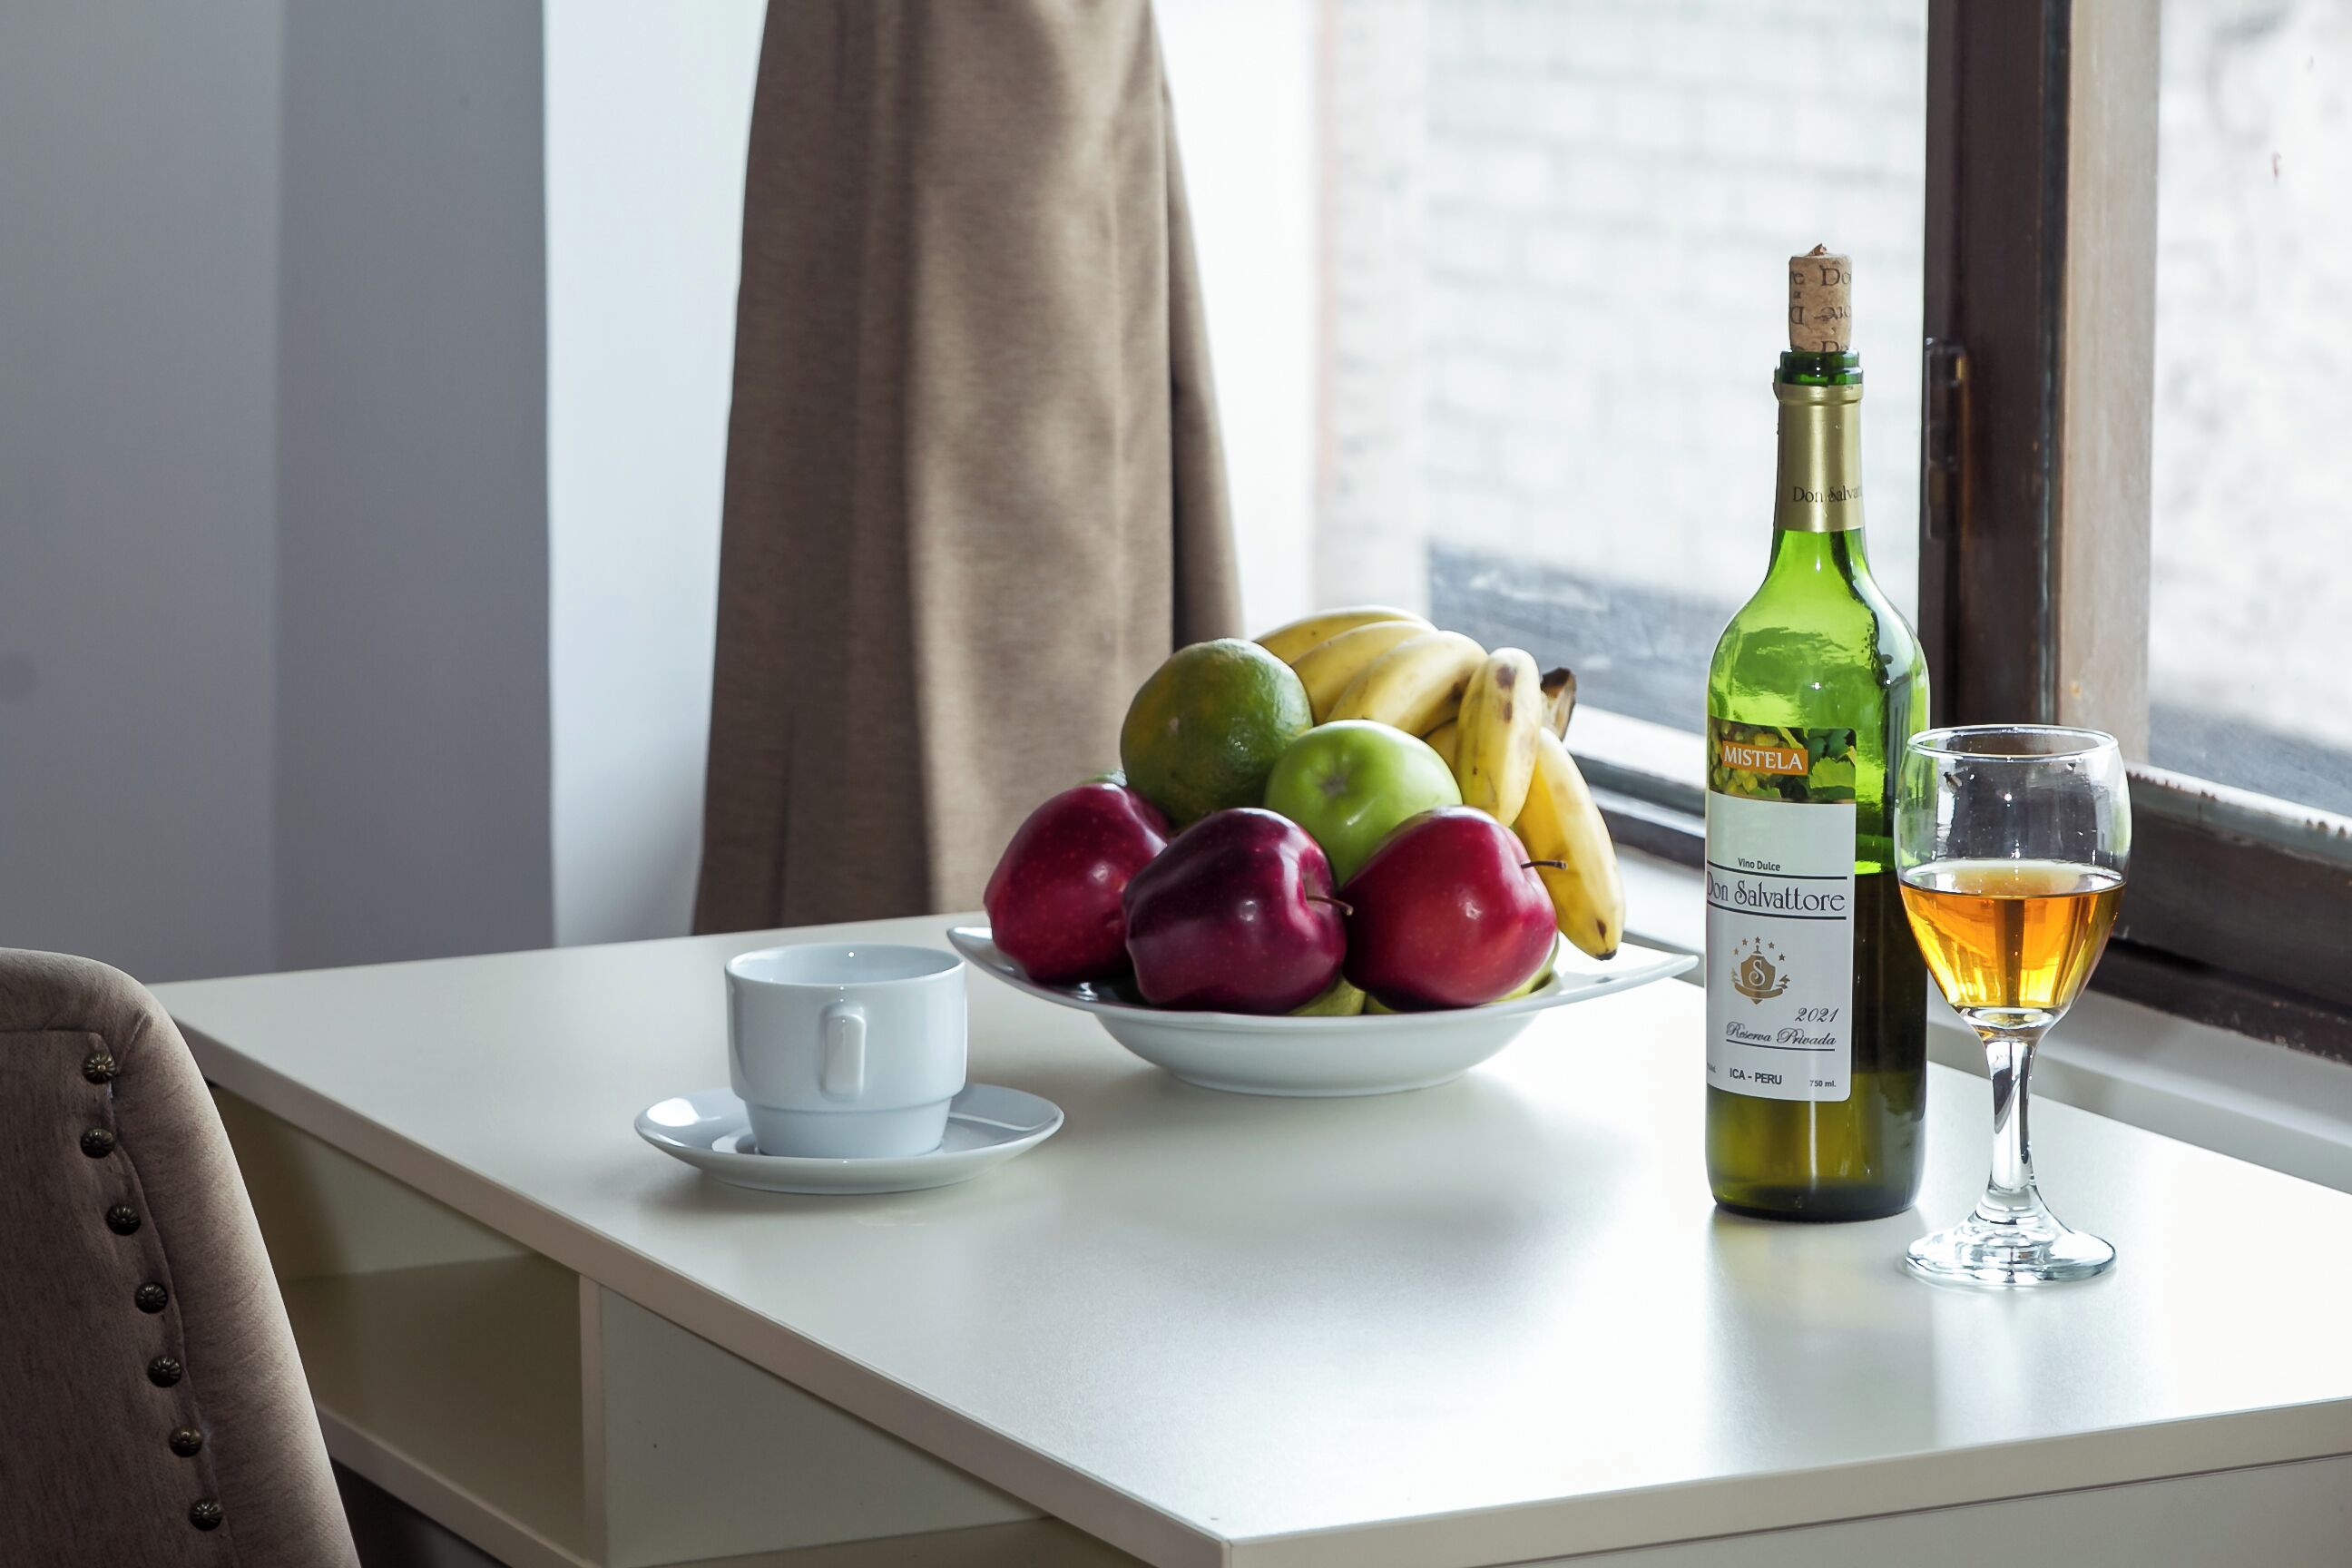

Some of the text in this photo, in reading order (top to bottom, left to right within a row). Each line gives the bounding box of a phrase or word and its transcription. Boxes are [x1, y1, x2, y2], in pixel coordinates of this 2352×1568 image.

[1793, 486, 1824, 503] Don
[1724, 745, 1803, 770] MISTELA
[1738, 858, 1781, 872] Vino Dulce
[1707, 871, 1846, 912] Don Salvattore
[1749, 959, 1766, 987] S
[1794, 1007, 1839, 1023] 2021
[1726, 1021, 1837, 1045] Reserva Privada
[1730, 1068, 1746, 1081] ICA
[1755, 1072, 1783, 1085] PERU
